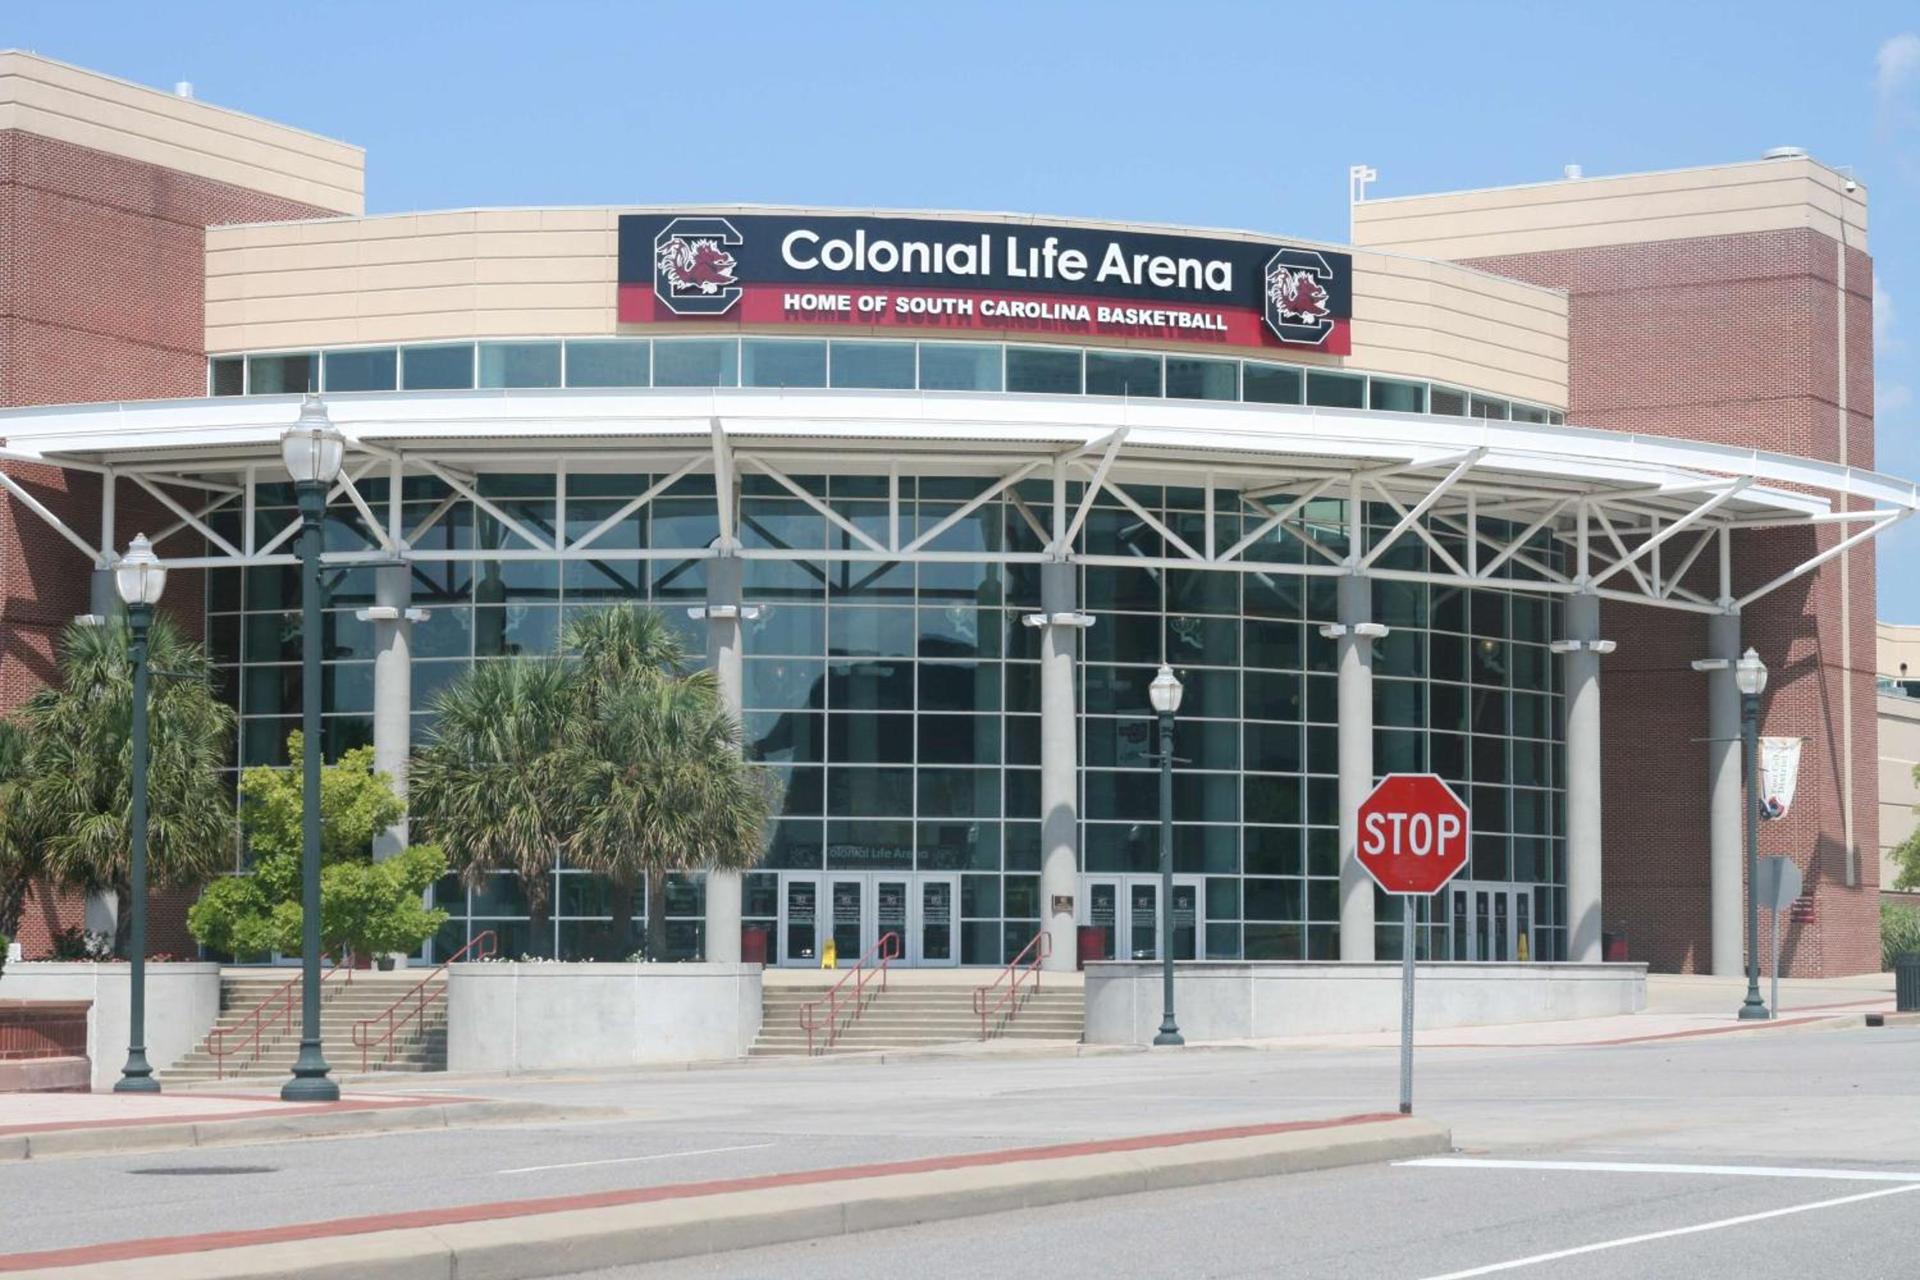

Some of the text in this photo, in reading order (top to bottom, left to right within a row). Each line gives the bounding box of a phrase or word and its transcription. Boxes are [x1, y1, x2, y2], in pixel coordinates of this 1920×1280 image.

[781, 229, 1232, 292] Colonial Life Arena
[784, 293, 1228, 331] HOME OF SOUTH CAROLINA BASKETBALL
[1363, 812, 1461, 856] STOP
